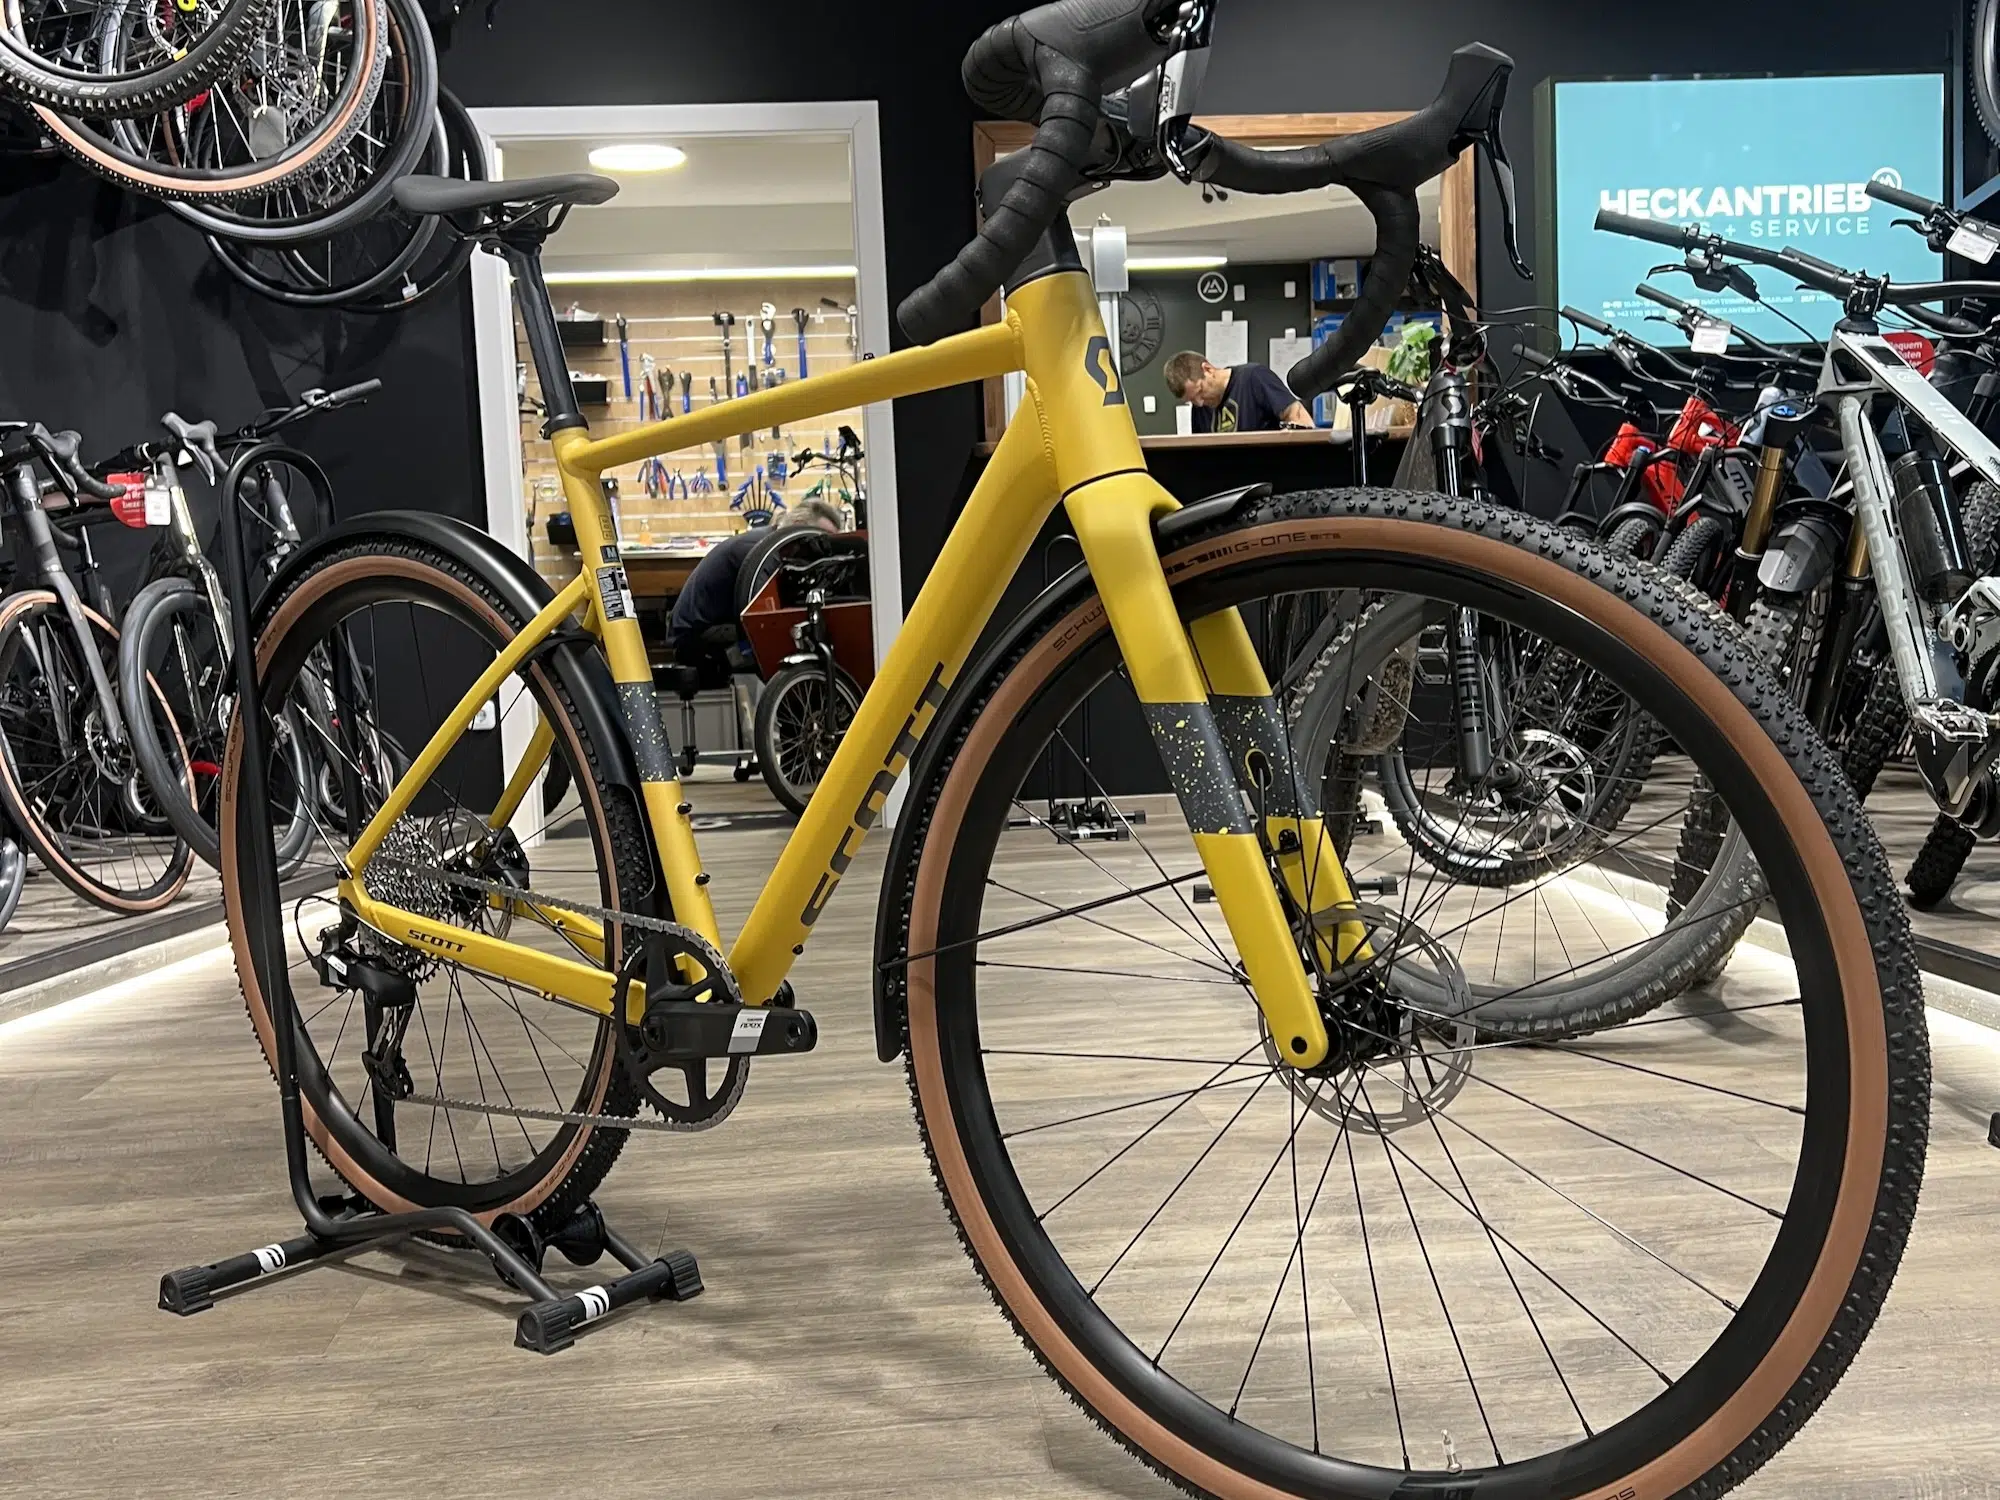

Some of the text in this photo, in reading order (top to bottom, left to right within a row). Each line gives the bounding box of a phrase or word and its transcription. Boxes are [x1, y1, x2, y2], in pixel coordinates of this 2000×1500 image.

[1600, 183, 1872, 217] HECKANTRIEB
[1750, 217, 1870, 237] SERVICE
[1235, 532, 1307, 553] G-ONE
[801, 660, 949, 927] SCOTT
[407, 929, 467, 953] SCOTT
